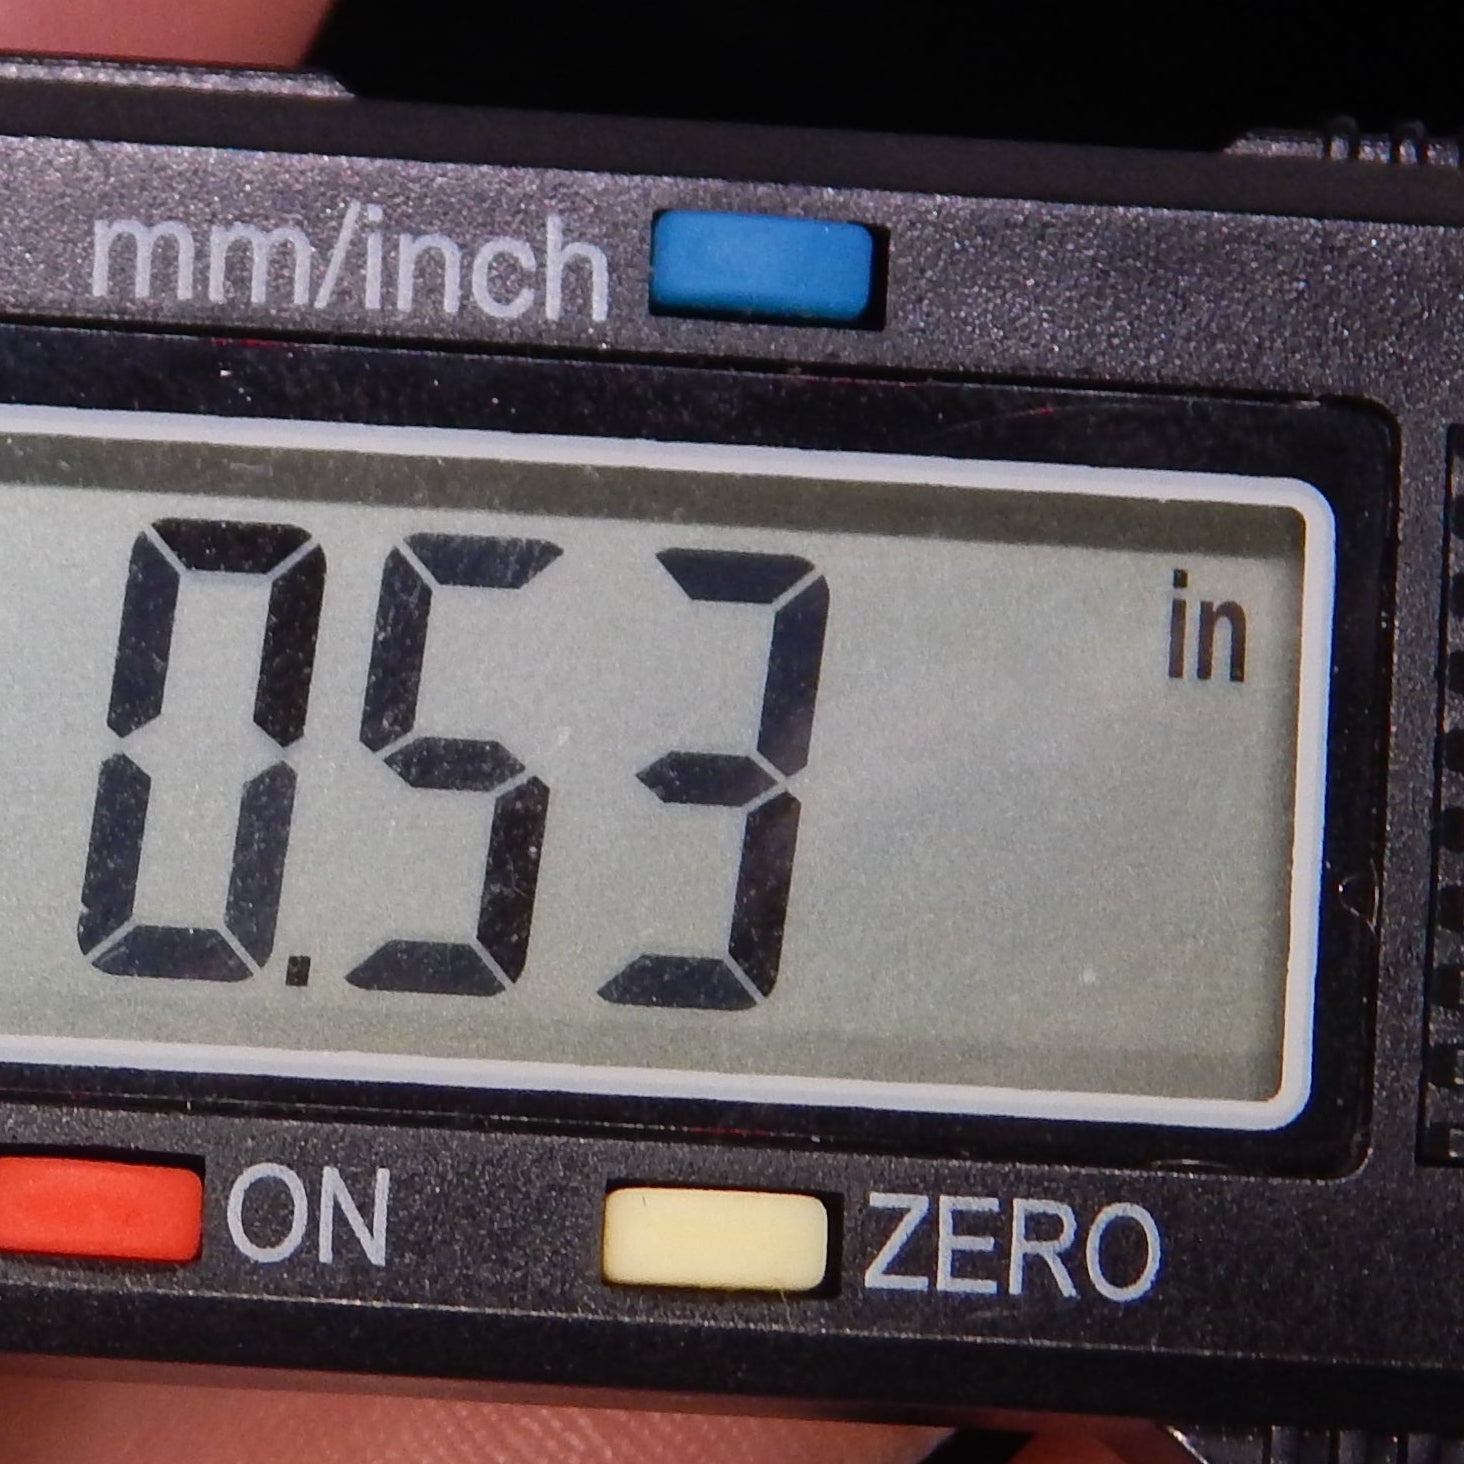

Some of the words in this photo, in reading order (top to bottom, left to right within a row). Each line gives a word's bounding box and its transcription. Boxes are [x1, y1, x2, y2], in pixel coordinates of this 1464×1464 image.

[90, 200, 612, 324] mm/inch
[1166, 569, 1248, 685] in
[78, 517, 830, 1010] 0.53
[225, 1161, 393, 1268] ON
[863, 1190, 1164, 1304] ZERO
